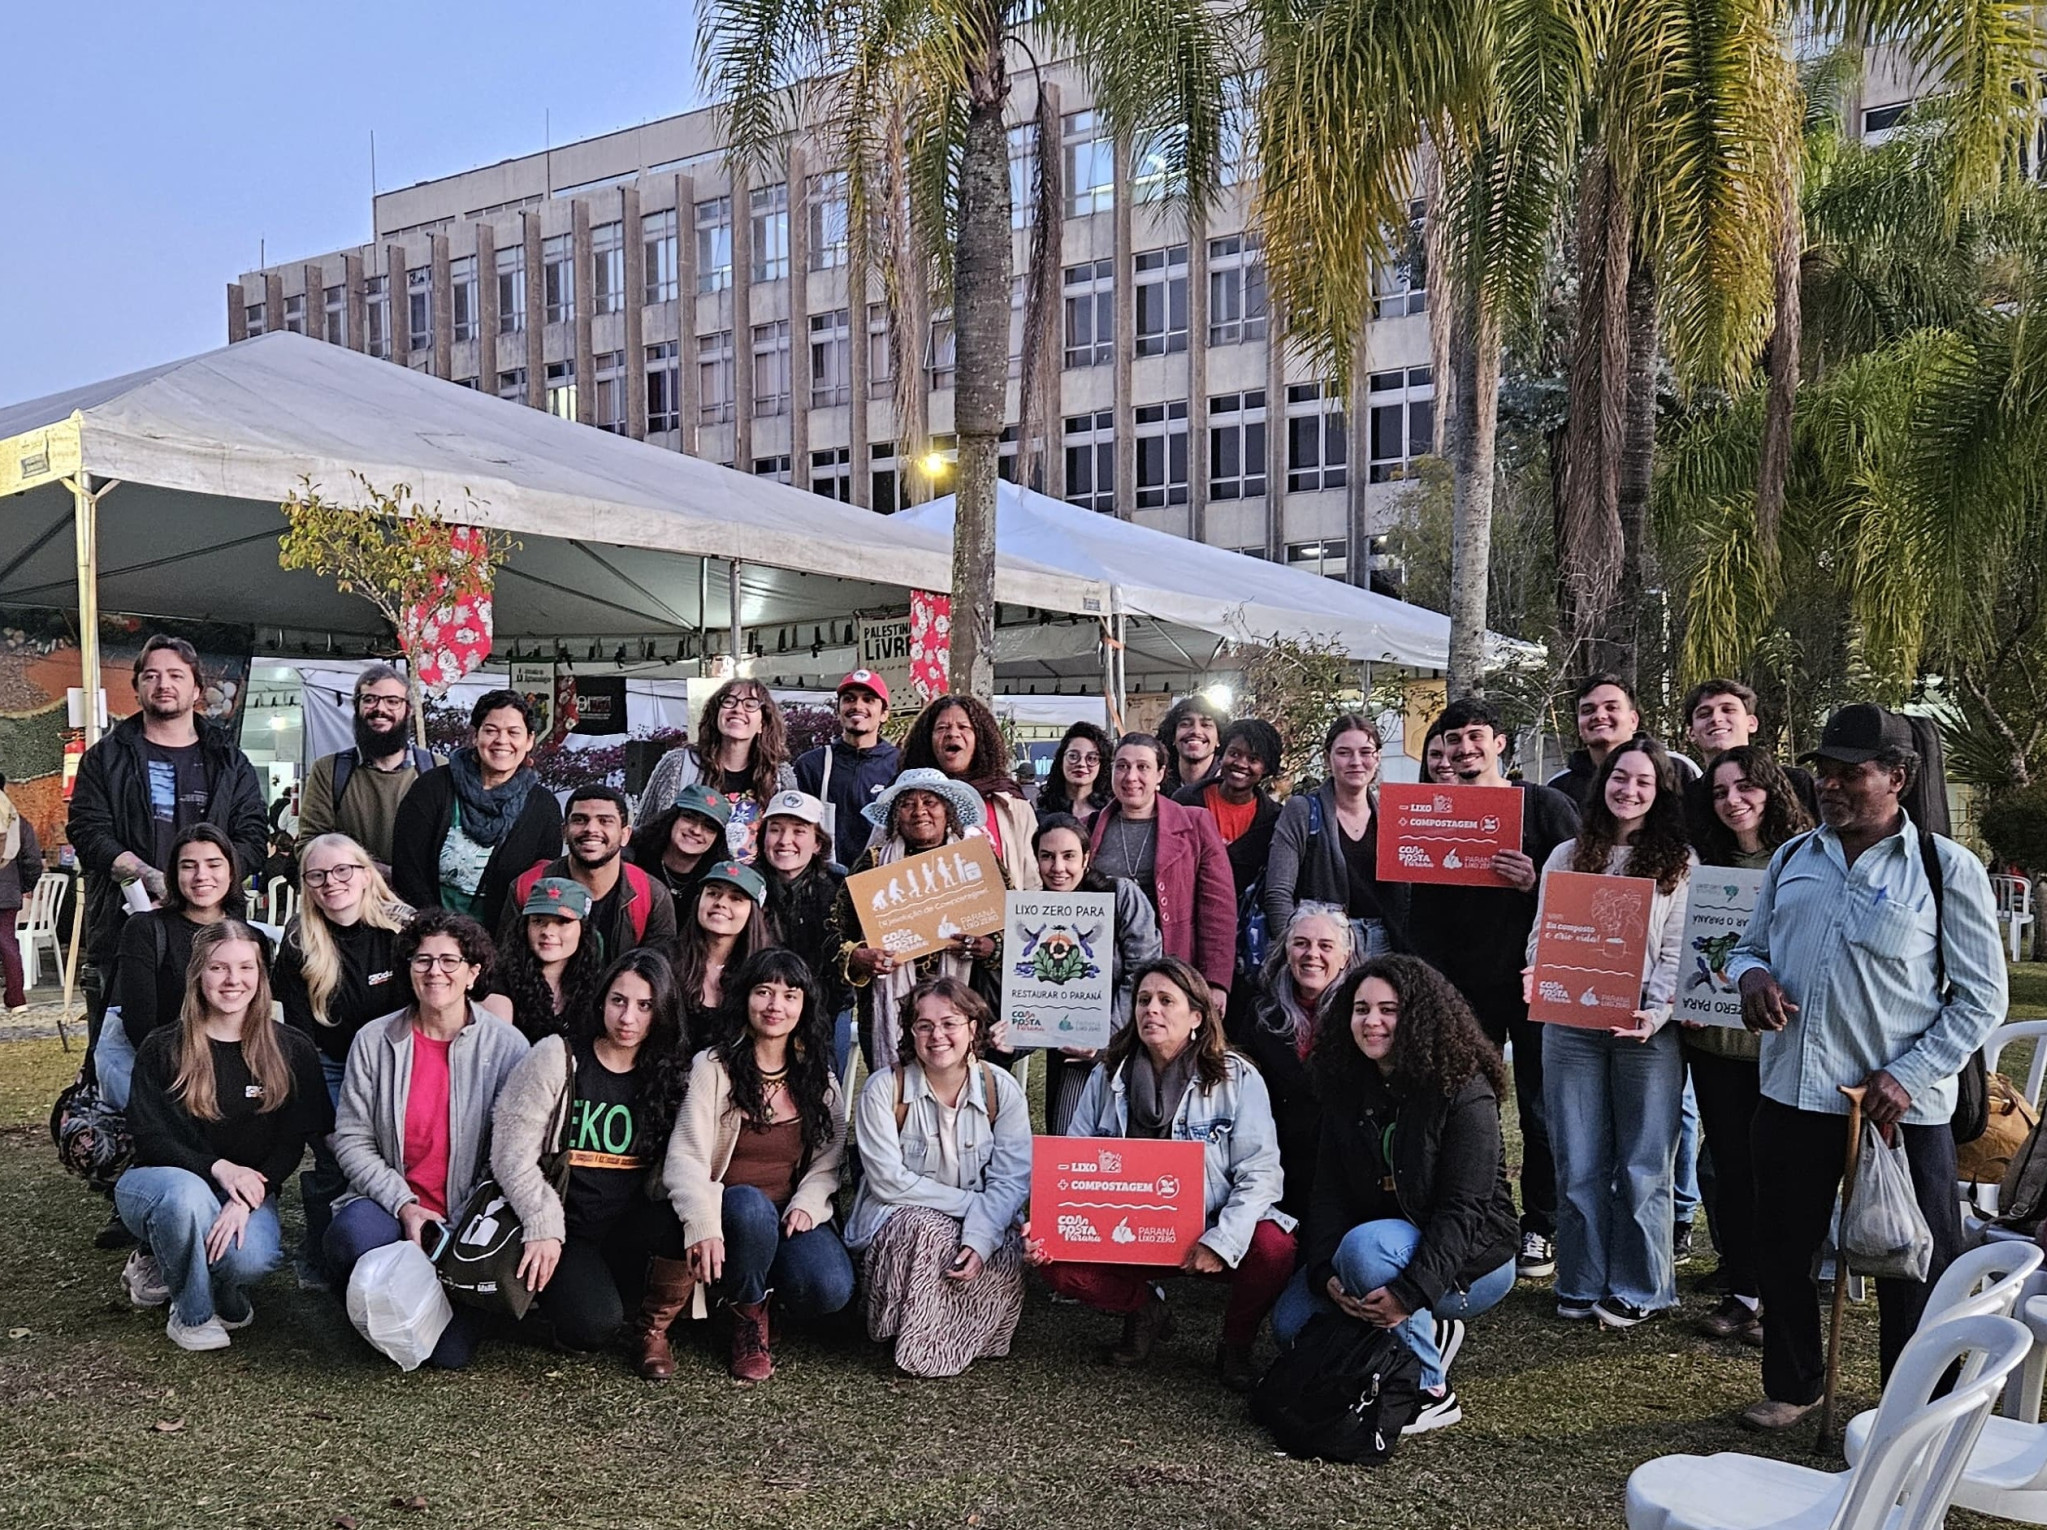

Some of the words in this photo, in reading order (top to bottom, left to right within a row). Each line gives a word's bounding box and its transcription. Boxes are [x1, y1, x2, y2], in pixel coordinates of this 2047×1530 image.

[1410, 804, 1432, 812] LIXO
[1410, 818, 1478, 829] COMPOSTAGEM
[1015, 904, 1038, 915] LIXO
[1042, 905, 1072, 916] ZERO
[1076, 905, 1105, 917] PARA
[1012, 989, 1058, 999] RESTAURAR
[1061, 991, 1067, 999] O
[1070, 990, 1102, 1000] PARANÁ
[1682, 997, 1711, 1012] PARA
[1012, 1018, 1041, 1026] POSTA
[1071, 1163, 1097, 1172] LIXO
[1071, 1180, 1153, 1192] COMPOSTAGEM
[1058, 1224, 1096, 1235] POSTA
[1138, 1226, 1176, 1237] PARANÁ
[1138, 1235, 1155, 1243] LIXO
[1155, 1235, 1176, 1243] ZERO
